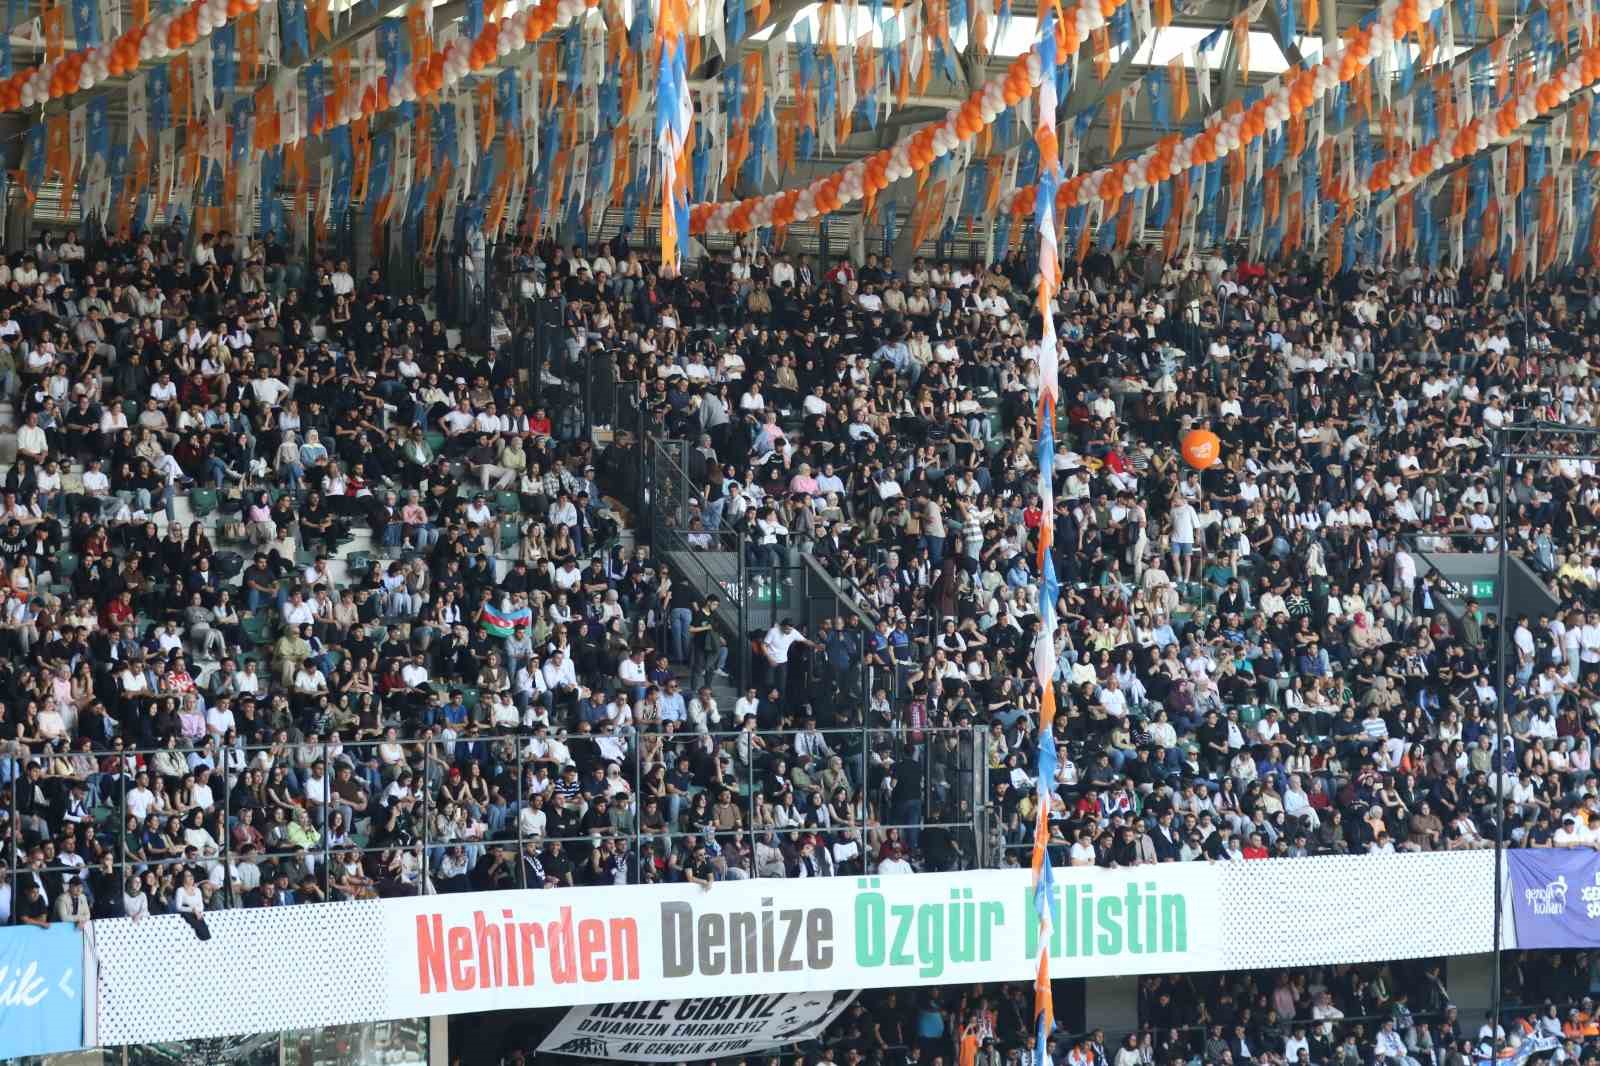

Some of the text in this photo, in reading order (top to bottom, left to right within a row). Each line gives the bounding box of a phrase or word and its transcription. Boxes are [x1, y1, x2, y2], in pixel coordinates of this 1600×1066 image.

[416, 906, 640, 994] Nehirden
[660, 897, 834, 978] Denize
[854, 878, 1005, 978] Özgür
[577, 1019, 671, 1037] DAVAMIZIN
[619, 1042, 645, 1054] AK
[704, 1039, 752, 1053] AFYON
